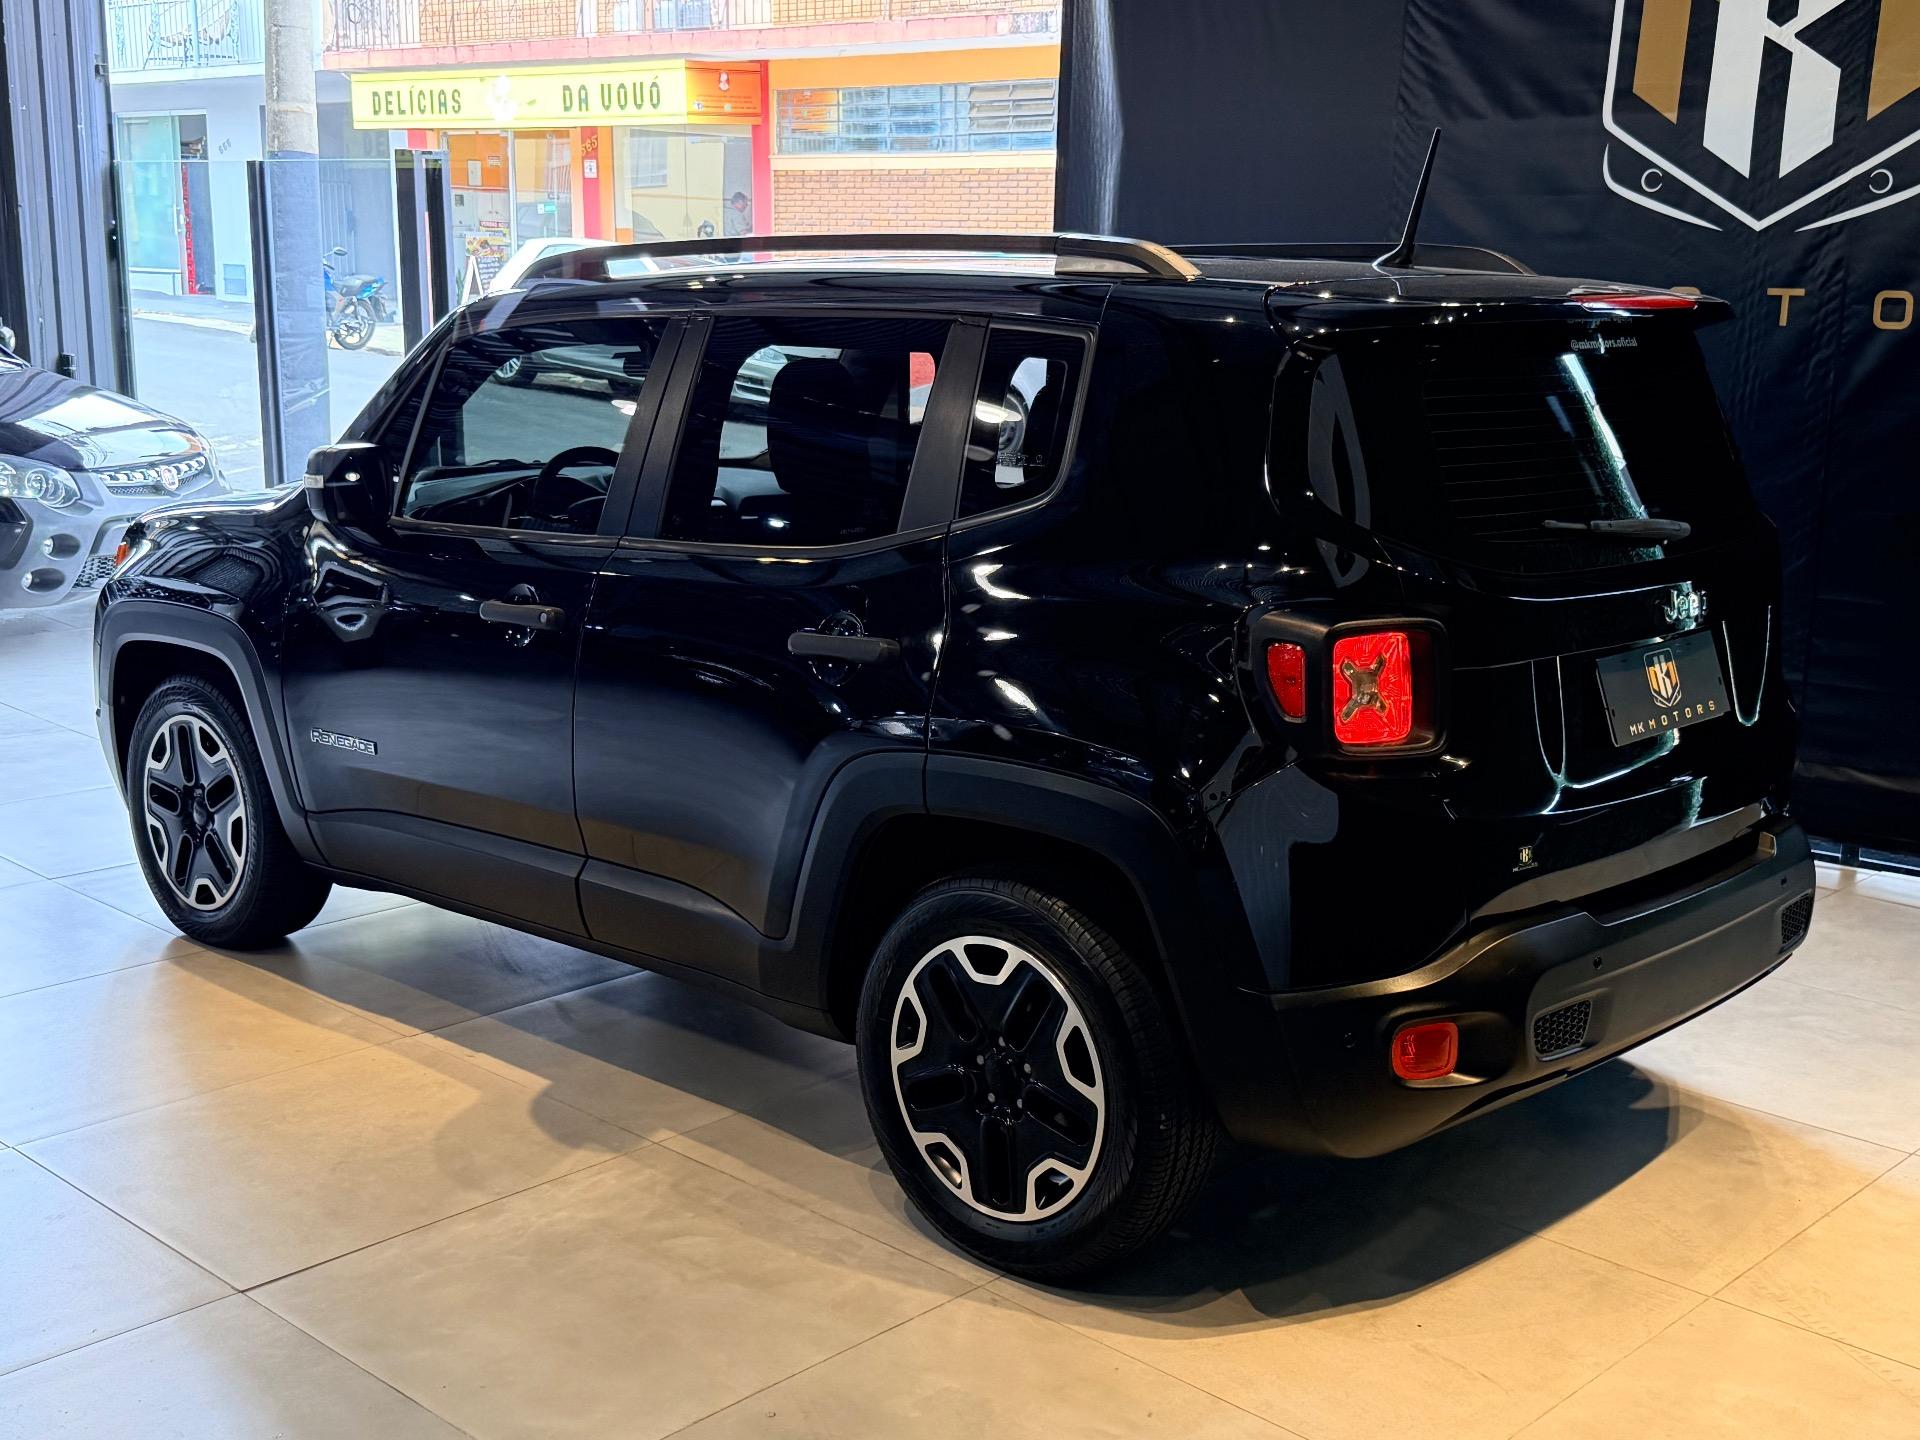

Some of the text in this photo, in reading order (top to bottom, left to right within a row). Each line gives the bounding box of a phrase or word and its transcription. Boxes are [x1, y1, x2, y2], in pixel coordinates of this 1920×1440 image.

[372, 85, 462, 115] DELÍCIAS
[562, 84, 589, 112] DA
[1648, 700, 1715, 730] MOTORS
[310, 727, 377, 755] RENEGADE
